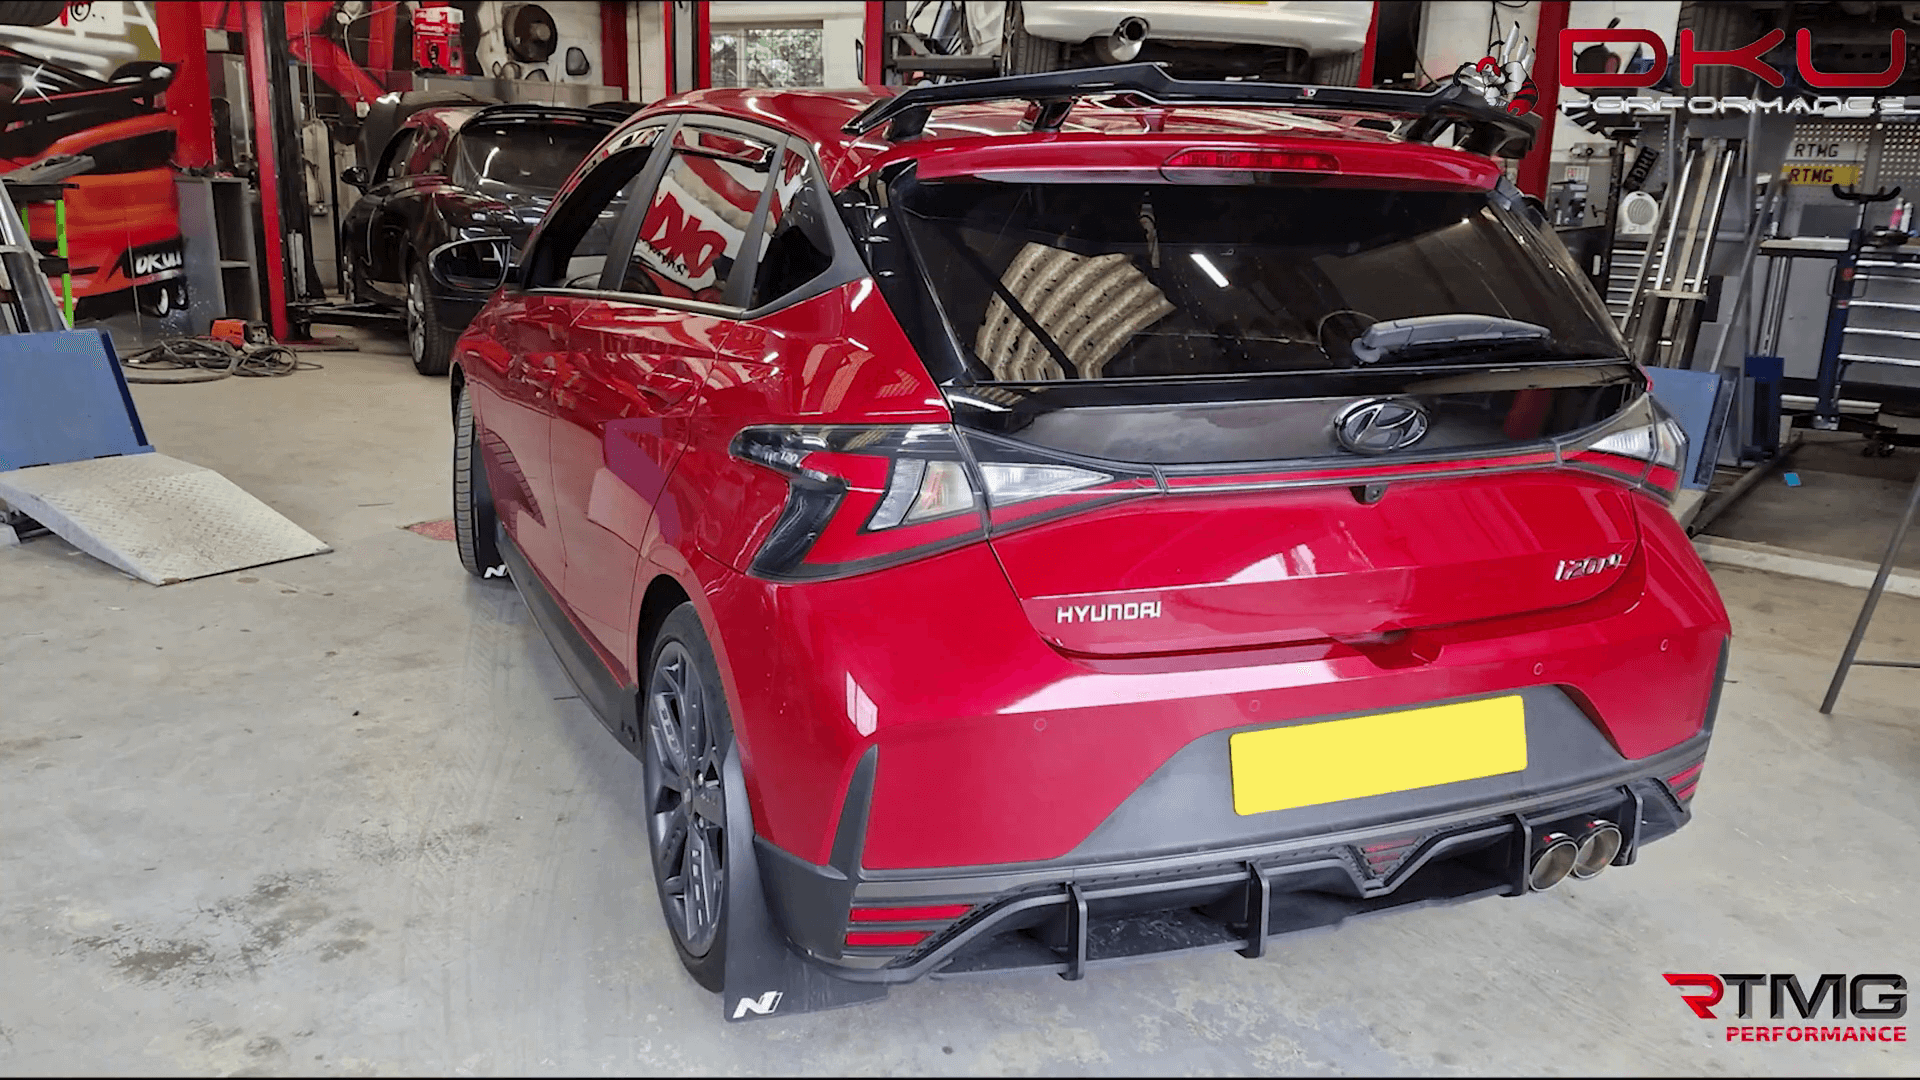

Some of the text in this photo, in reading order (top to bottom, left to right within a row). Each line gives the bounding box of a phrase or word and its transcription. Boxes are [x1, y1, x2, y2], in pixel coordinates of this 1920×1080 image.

[1794, 143, 1839, 158] RTMG
[1789, 168, 1834, 183] RTMG
[1057, 601, 1162, 624] HYUNDAI
